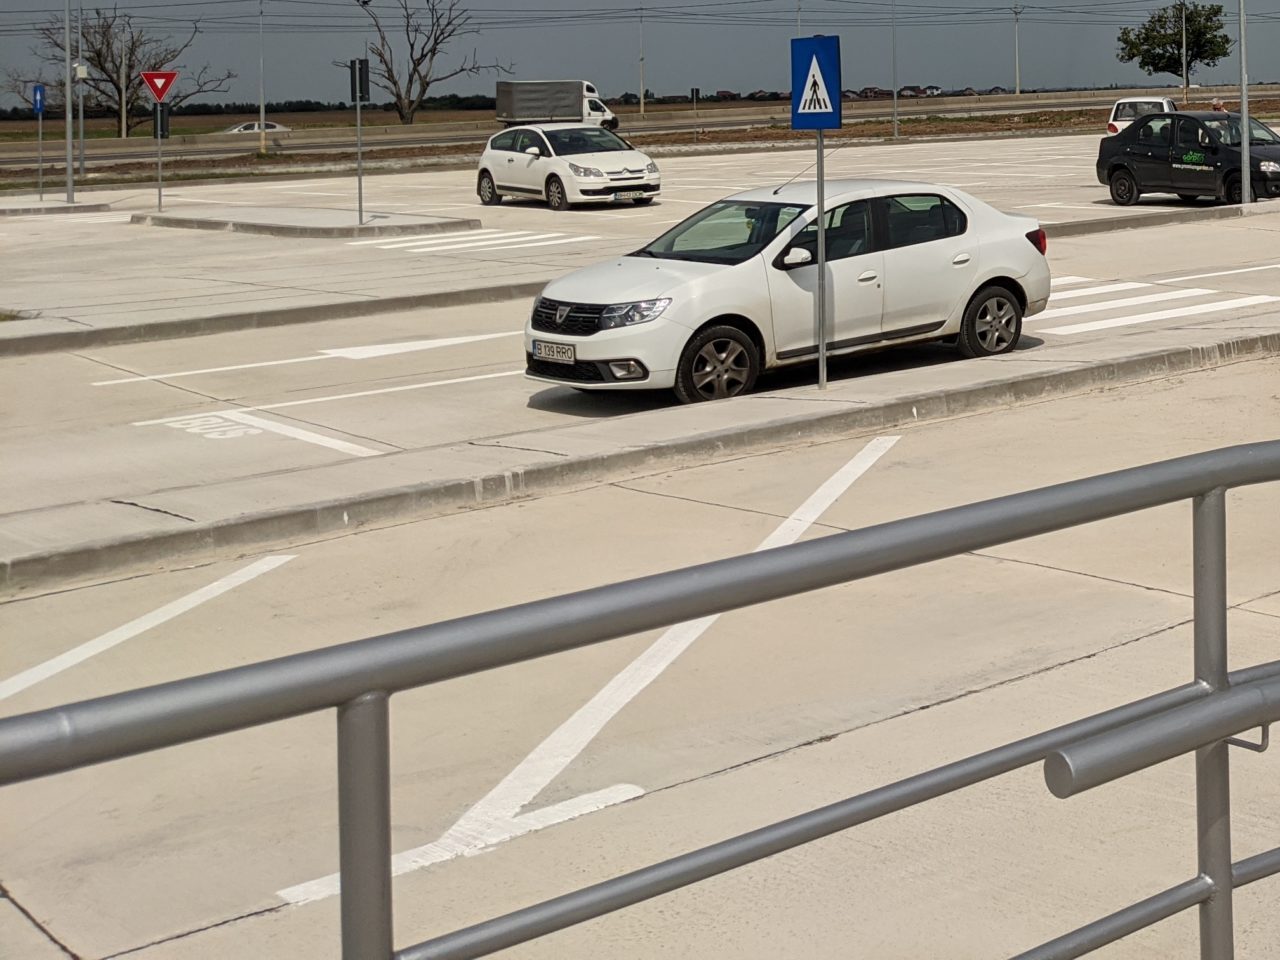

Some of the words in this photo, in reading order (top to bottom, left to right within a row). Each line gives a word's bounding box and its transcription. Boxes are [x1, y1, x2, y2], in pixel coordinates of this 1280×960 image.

[537, 343, 542, 355] B
[544, 344, 555, 357] 139
[555, 346, 573, 359] RRO
[164, 415, 263, 439] BUS
